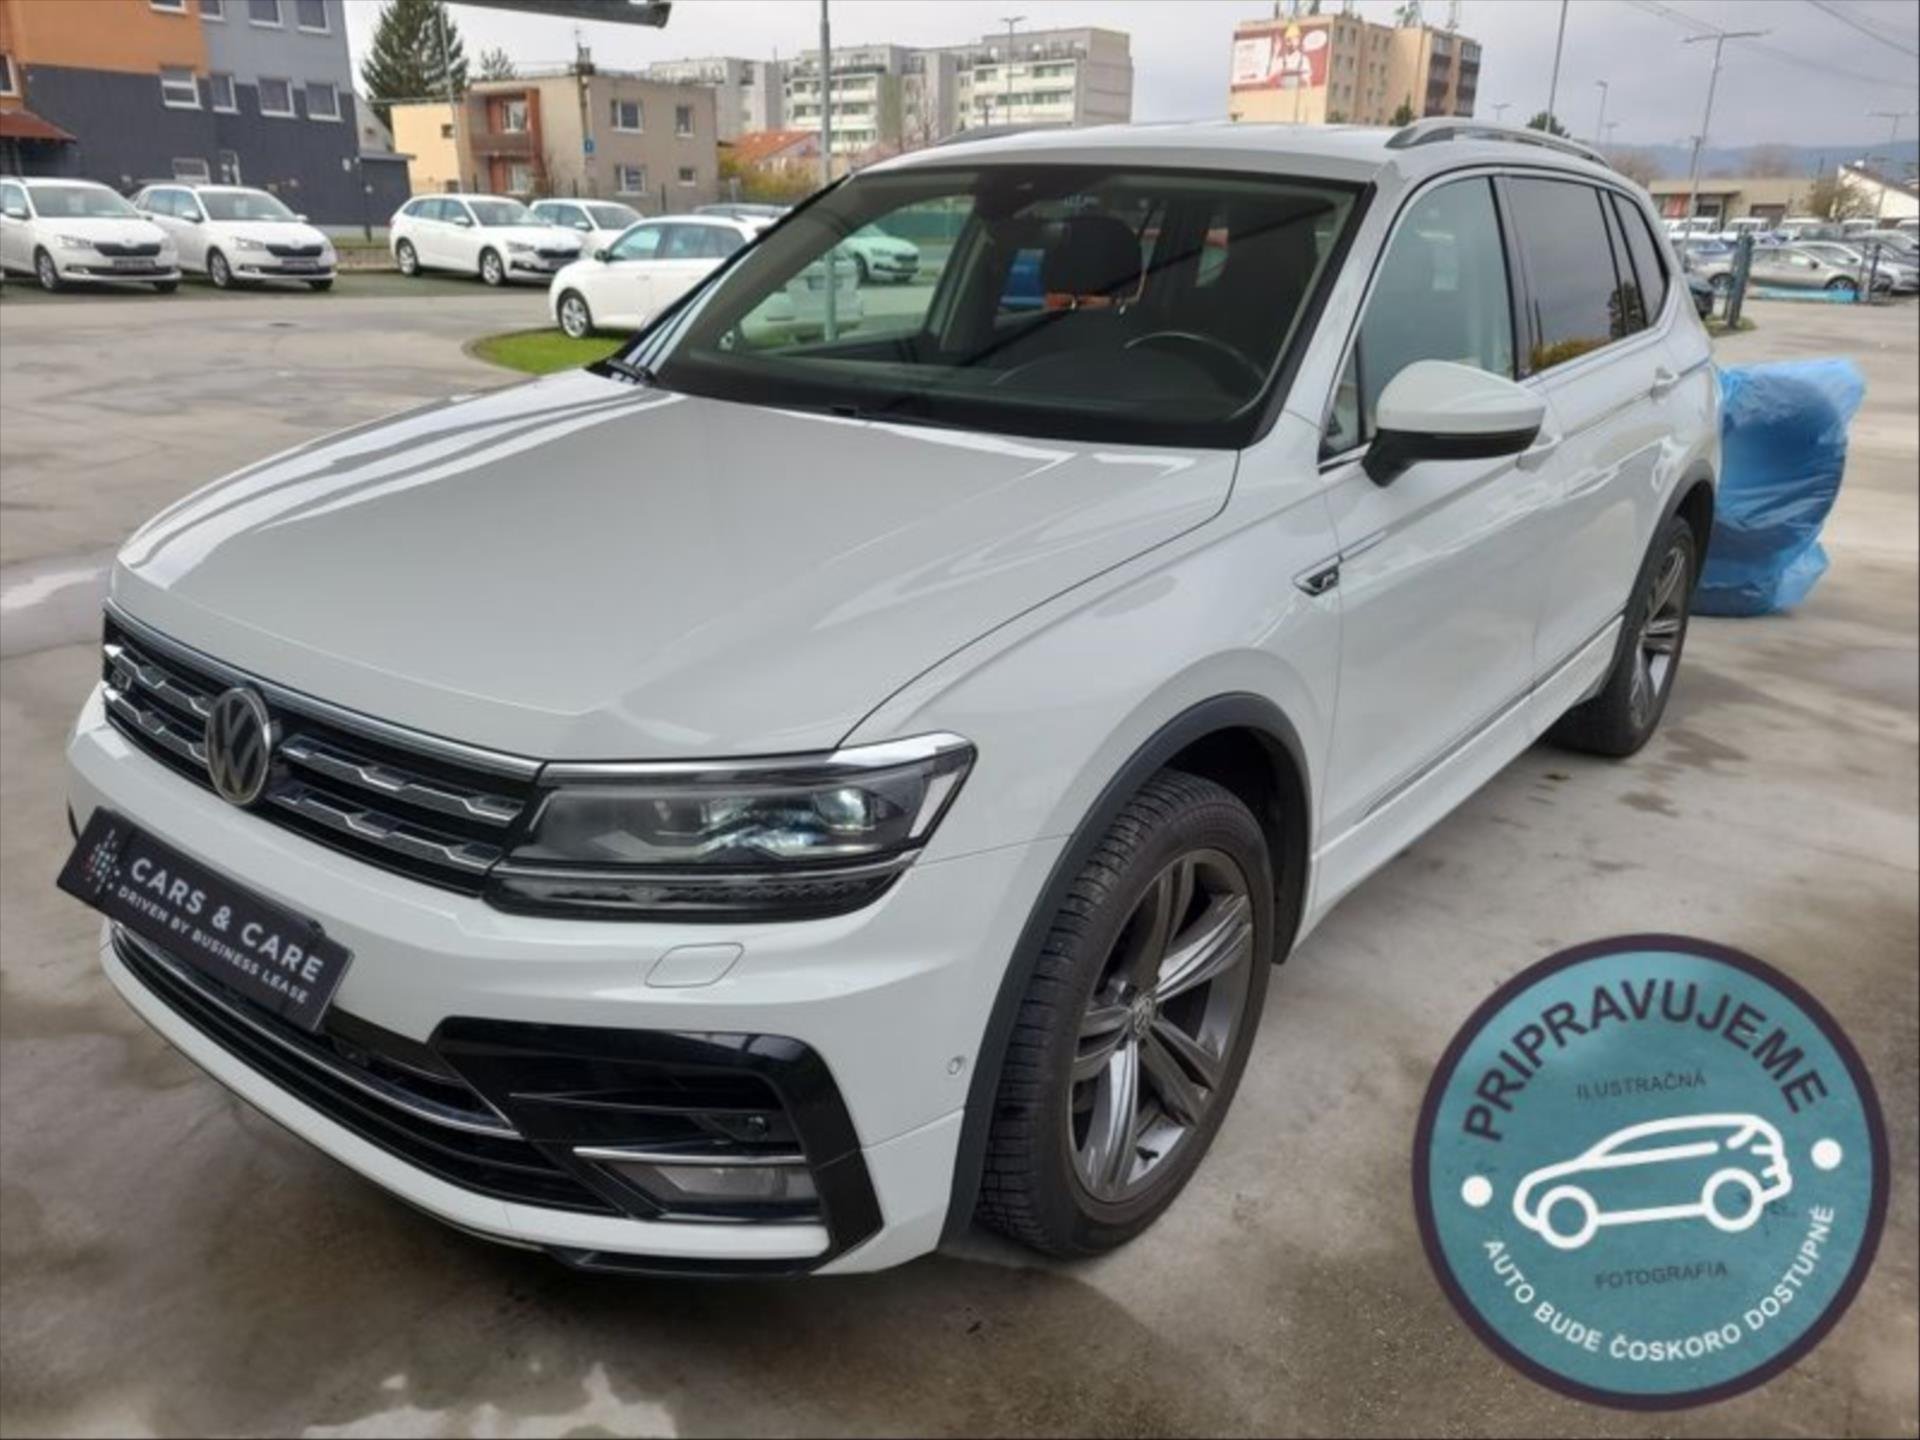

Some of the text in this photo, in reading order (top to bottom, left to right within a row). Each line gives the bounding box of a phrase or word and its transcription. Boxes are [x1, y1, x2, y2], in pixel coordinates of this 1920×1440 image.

[118, 886, 308, 1004] DRIVEN BY BUSINESS LEASE
[130, 858, 324, 983] CARS & CARE
